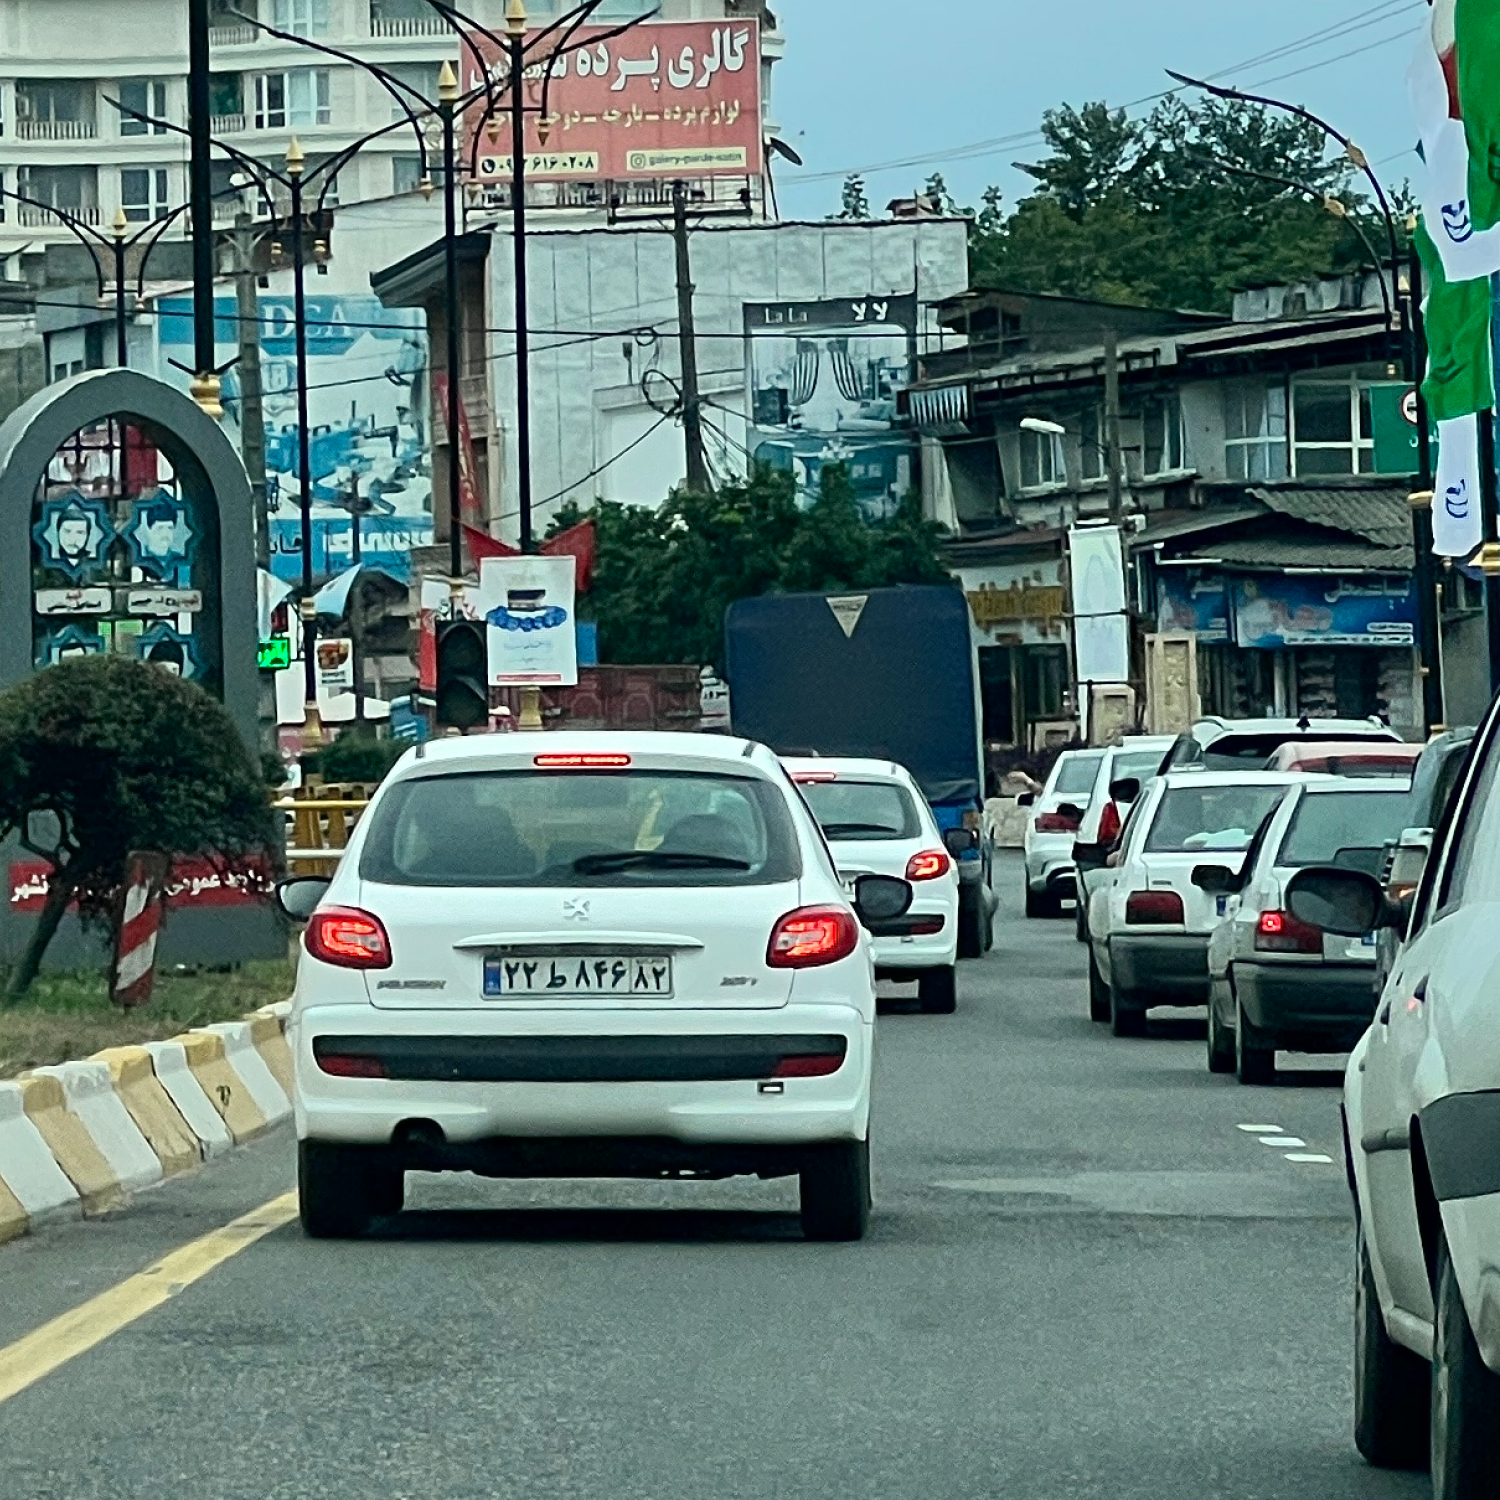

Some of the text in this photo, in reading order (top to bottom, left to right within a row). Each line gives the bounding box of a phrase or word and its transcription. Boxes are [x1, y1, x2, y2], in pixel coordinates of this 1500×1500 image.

[577, 43, 659, 92] پرده
[668, 27, 749, 89] گالری
[505, 960, 538, 989] ۲۲
[575, 960, 627, 988] ۸۴۶
[634, 966, 666, 990] ۸۲
